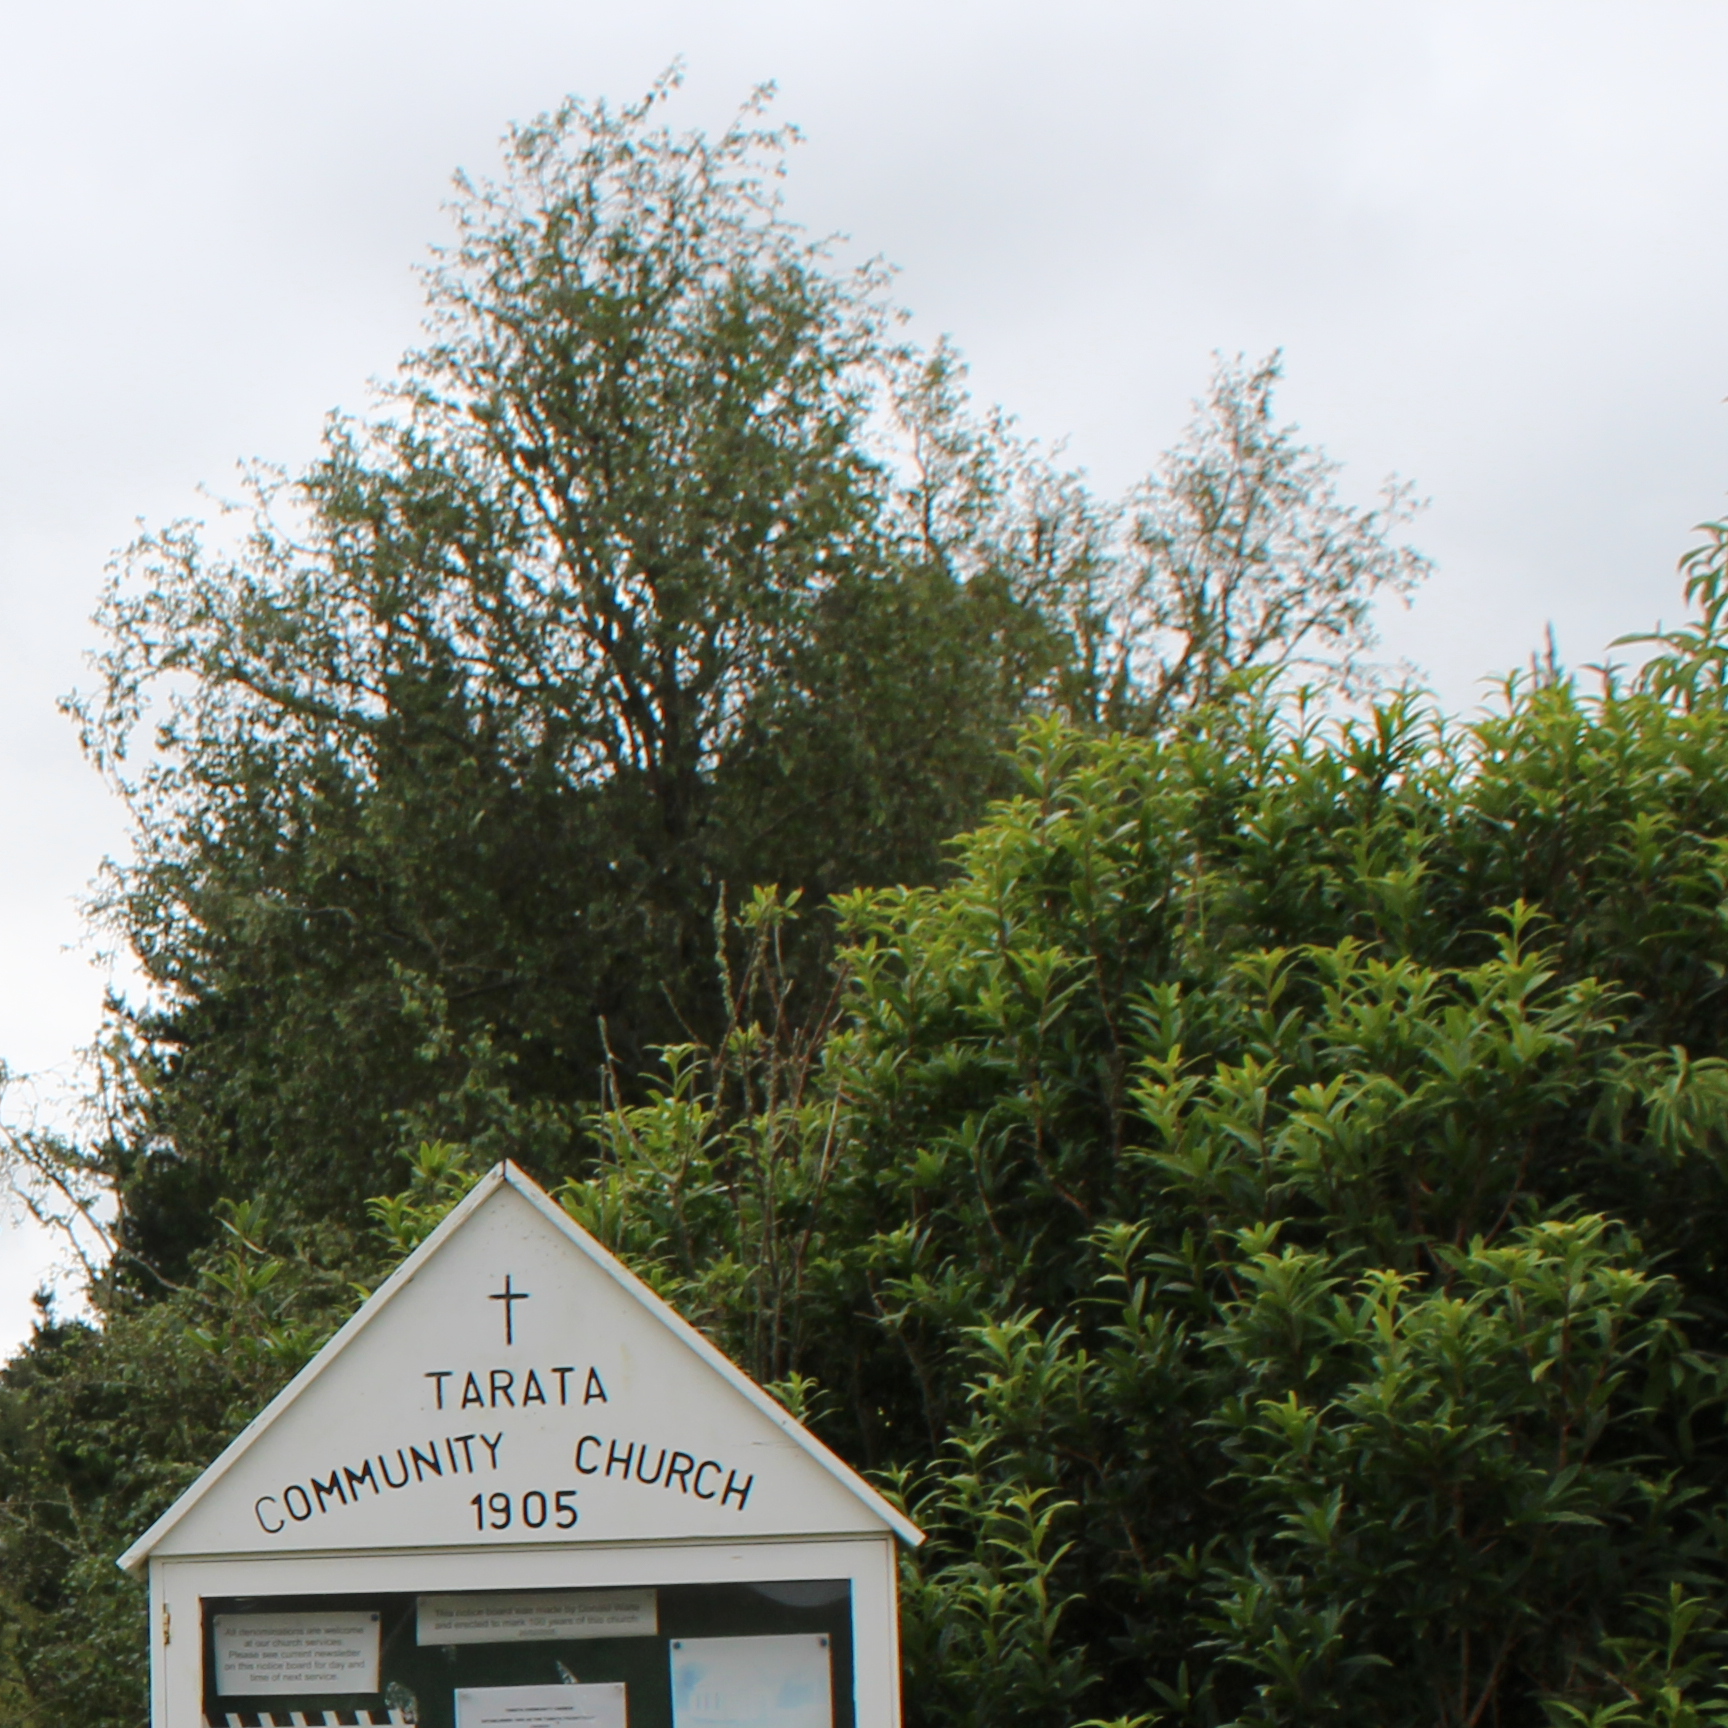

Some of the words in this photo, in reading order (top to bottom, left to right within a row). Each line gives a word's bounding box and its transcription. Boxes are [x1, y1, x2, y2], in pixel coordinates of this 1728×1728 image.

[425, 1366, 608, 1410] TARATA
[254, 1431, 503, 1534] COMMUNITY
[575, 1435, 754, 1511] CHURCH
[470, 1489, 579, 1531] 1905
[238, 1627, 304, 1636] denominations
[324, 1626, 364, 1634] welcome
[272, 1638, 303, 1647] church
[228, 1650, 260, 1658] Please
[281, 1650, 312, 1658] current
[314, 1649, 362, 1657] newsletter
[238, 1662, 254, 1670] this
[256, 1662, 284, 1670] notice
[286, 1661, 312, 1670] board
[314, 1661, 326, 1669] for
[328, 1661, 345, 1670] day
[250, 1674, 270, 1682] time
[282, 1673, 303, 1681] next
